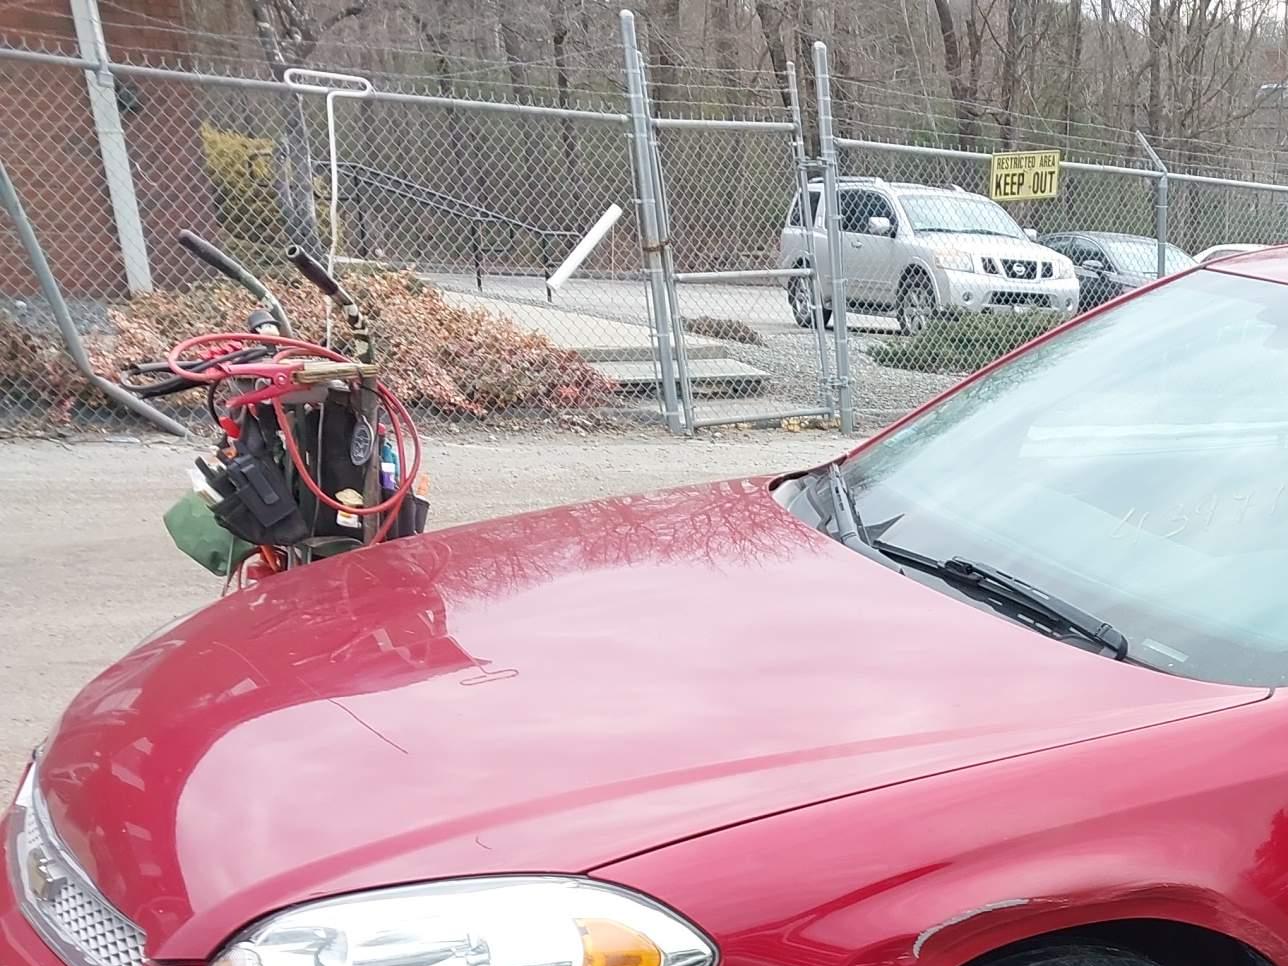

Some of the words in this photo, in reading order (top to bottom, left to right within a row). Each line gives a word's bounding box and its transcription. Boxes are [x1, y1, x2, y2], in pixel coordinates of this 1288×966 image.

[997, 156, 1035, 169] RESTRICTED
[1040, 155, 1055, 167] AREA
[995, 173, 1024, 196] KEEP
[1033, 171, 1055, 193] OUT
